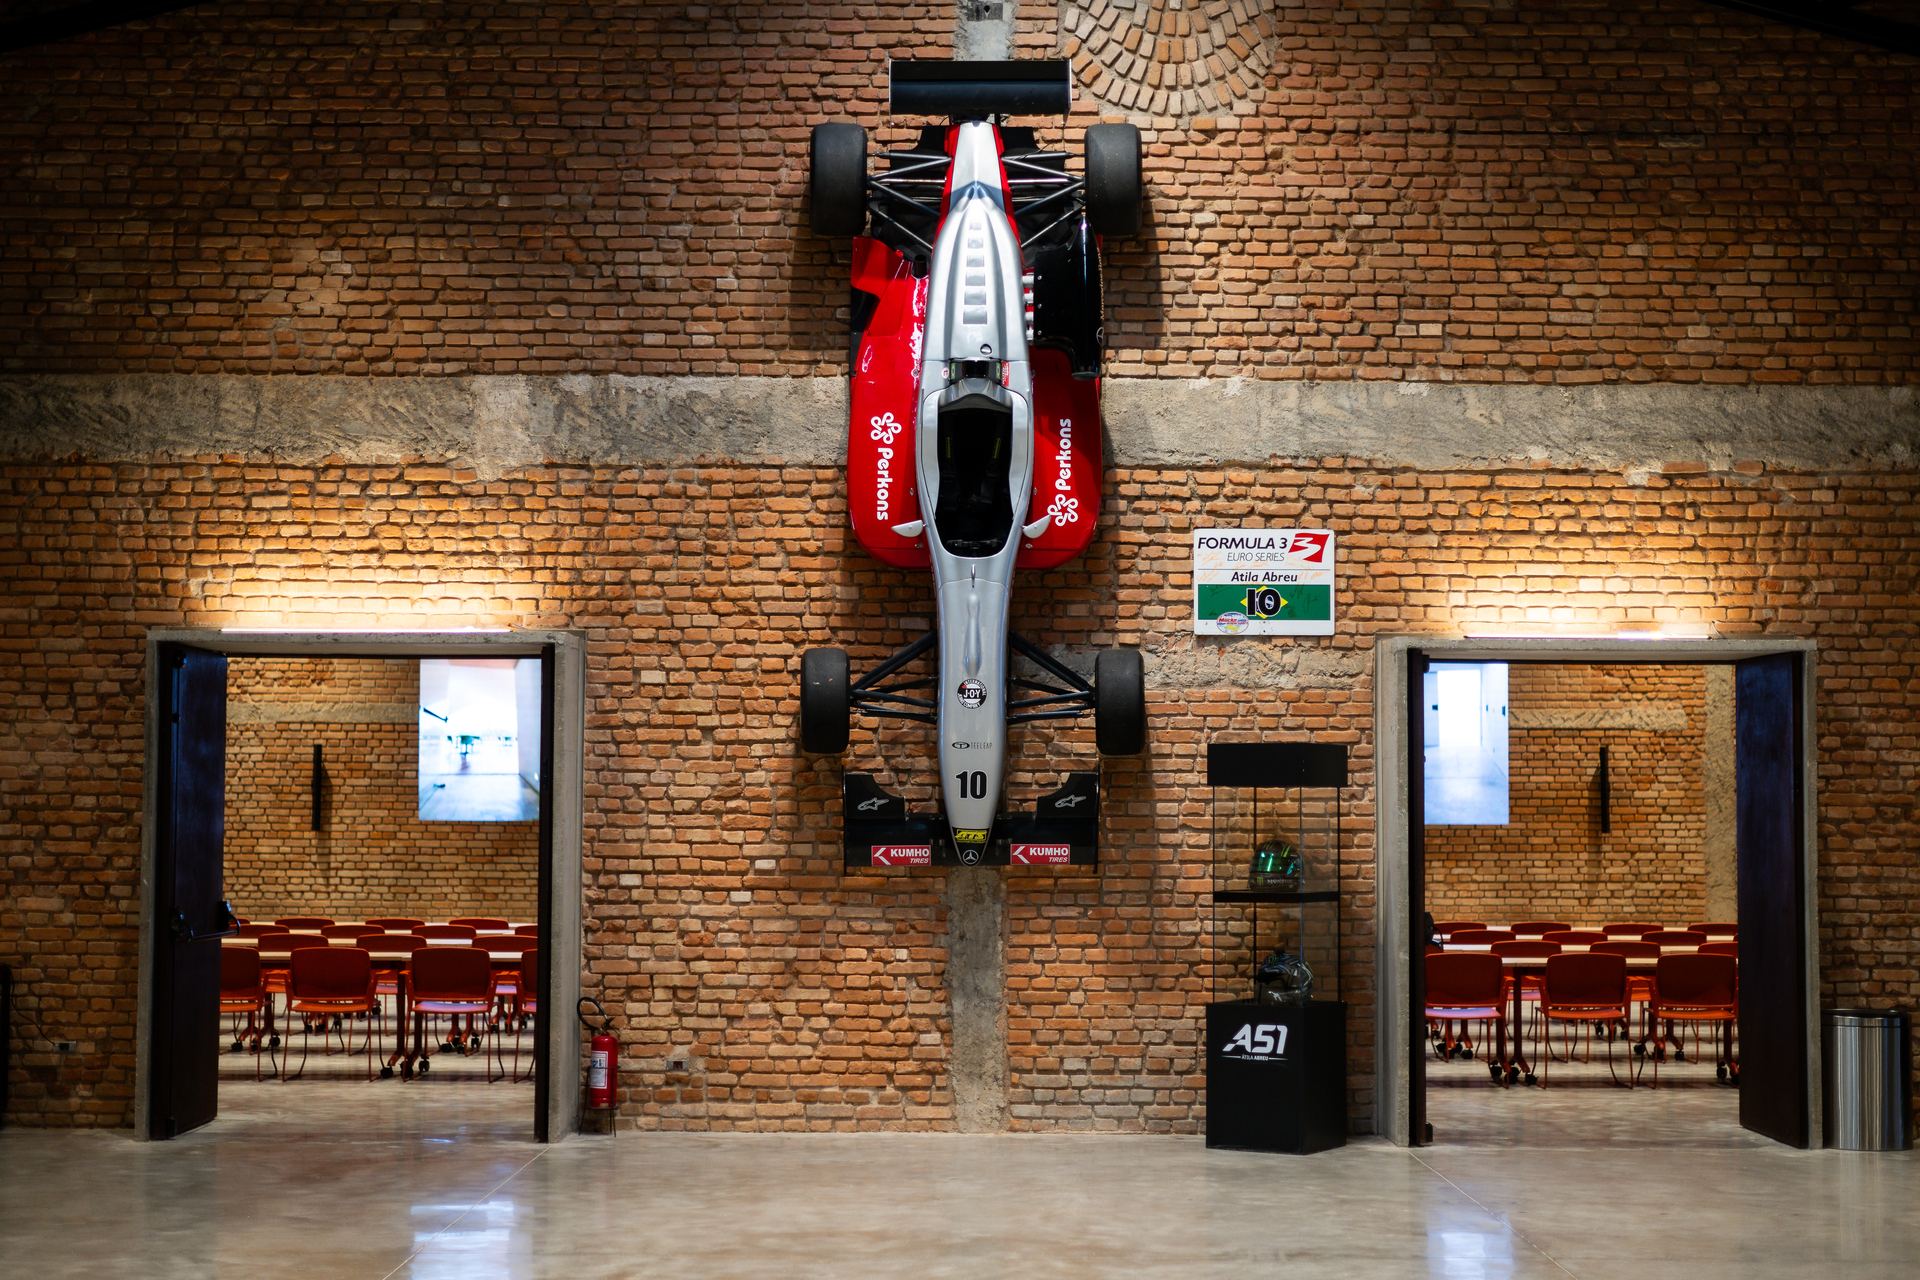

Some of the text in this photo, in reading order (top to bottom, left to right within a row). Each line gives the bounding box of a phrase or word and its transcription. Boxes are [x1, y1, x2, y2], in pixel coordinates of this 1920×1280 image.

[1055, 418, 1072, 491] Perkons
[876, 447, 894, 521] Perkons
[1197, 537, 1288, 549] FORMULA 3
[1227, 552, 1285, 562] EURO SERIES
[1231, 571, 1298, 582] Atila Abreu
[1246, 588, 1282, 617] 10
[955, 770, 987, 799] 10
[890, 848, 930, 857] KUMHO
[1029, 847, 1069, 856] KUMHO
[1222, 1023, 1288, 1054] A51
